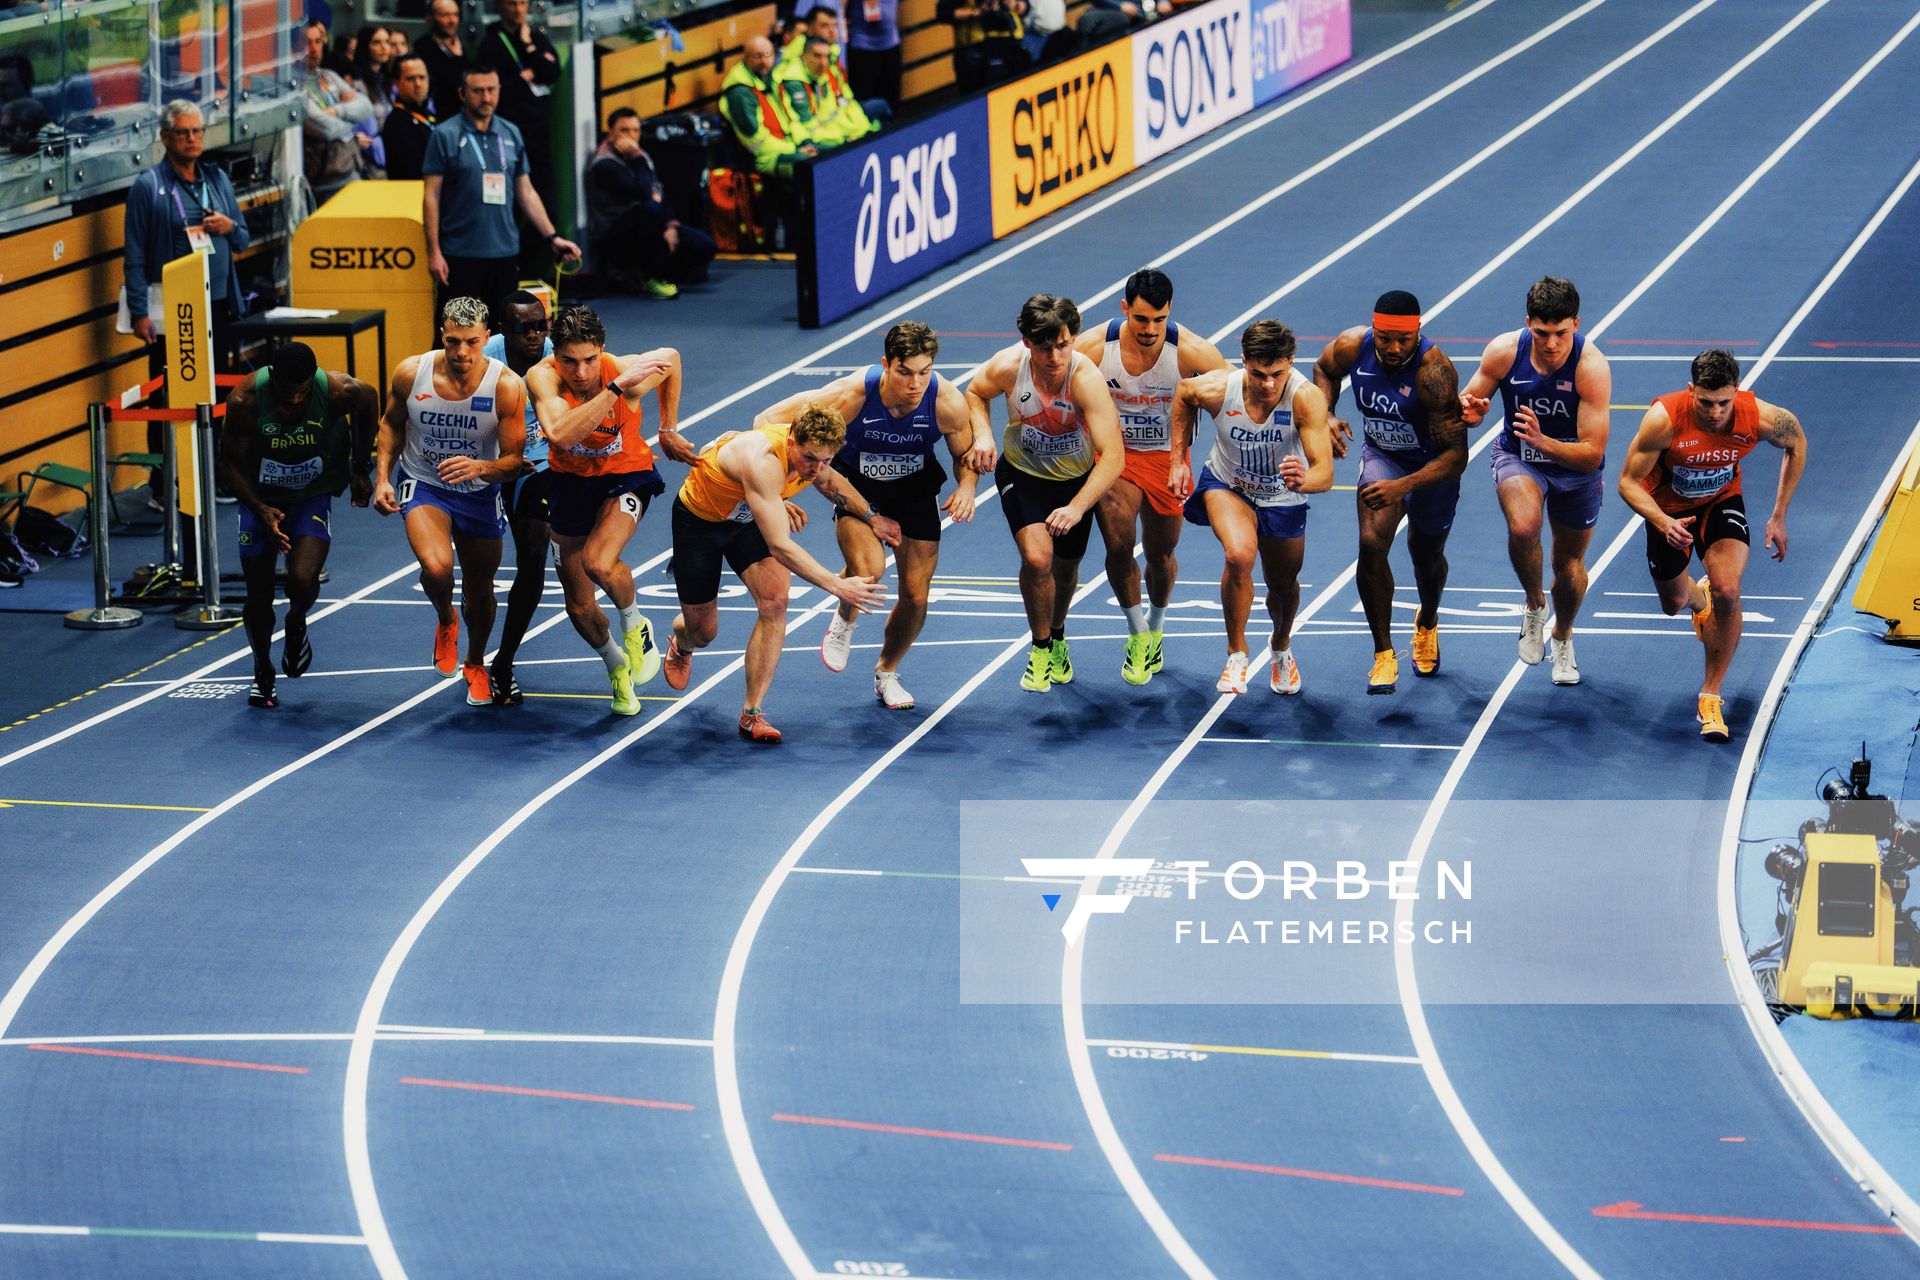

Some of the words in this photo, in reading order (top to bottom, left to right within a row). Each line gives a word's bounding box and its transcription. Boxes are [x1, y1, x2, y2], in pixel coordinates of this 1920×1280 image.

[1146, 11, 1240, 139] SONY
[1013, 62, 1118, 208] SEIKO
[887, 131, 957, 264] asics
[310, 246, 416, 270] SEIKO
[177, 303, 196, 382] SEIKO
[1359, 386, 1405, 421] USA
[1515, 395, 1571, 418] USA
[420, 411, 478, 430] CZECHIA
[1119, 415, 1161, 425] TDK
[1369, 419, 1410, 433] TDK
[271, 433, 317, 449] BRASIL
[864, 430, 923, 443] ESTONIA
[1037, 431, 1076, 441] TDK
[1230, 426, 1283, 442] CZECHIA
[435, 439, 477, 450] TDK
[1022, 437, 1080, 452] HAUTTEKEETE
[876, 454, 919, 463] TDK
[277, 459, 318, 474] TDK
[863, 463, 921, 477] ROOSLEHT
[263, 471, 319, 486] FERREIRA
[1107, 1047, 1209, 1062] 4x200
[833, 1260, 910, 1276] 200
